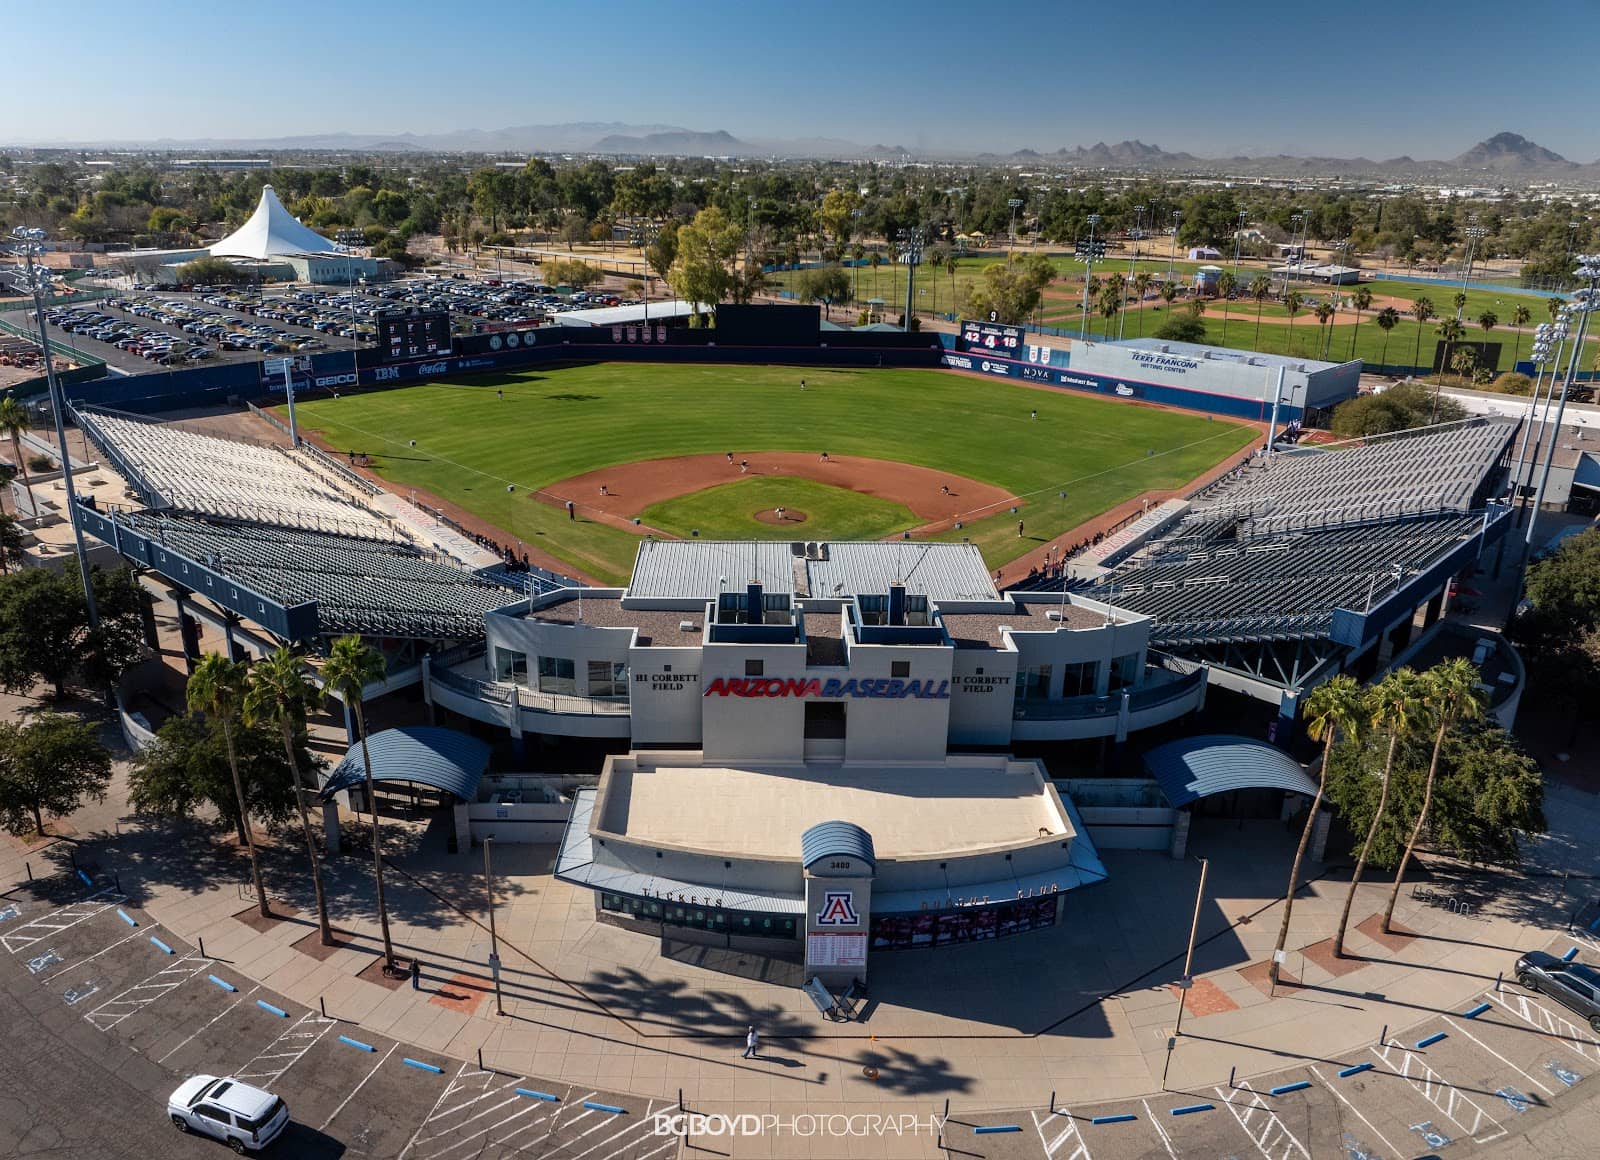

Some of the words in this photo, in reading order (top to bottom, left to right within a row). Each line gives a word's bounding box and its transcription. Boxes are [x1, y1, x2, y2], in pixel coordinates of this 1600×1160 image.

[990, 311, 997, 322] 9
[964, 331, 980, 343] 42
[984, 335, 996, 349] 4
[1003, 336, 1017, 348] 18
[1131, 354, 1154, 364] TERRY
[1155, 357, 1198, 369] FRANCONA
[374, 366, 400, 381] IBM
[1023, 367, 1049, 378] NOVA
[1140, 362, 1163, 371] HITTING
[1164, 366, 1186, 374] CENTER
[315, 373, 357, 387] GEICO
[635, 674, 648, 682] HI
[651, 674, 698, 682] CORBETT
[963, 676, 1011, 684] CORBETT
[652, 683, 684, 691] FIELD
[963, 685, 993, 693] FIELD
[830, 861, 851, 869] 3400
[642, 887, 723, 909] TICKETS
[816, 892, 860, 926] A
